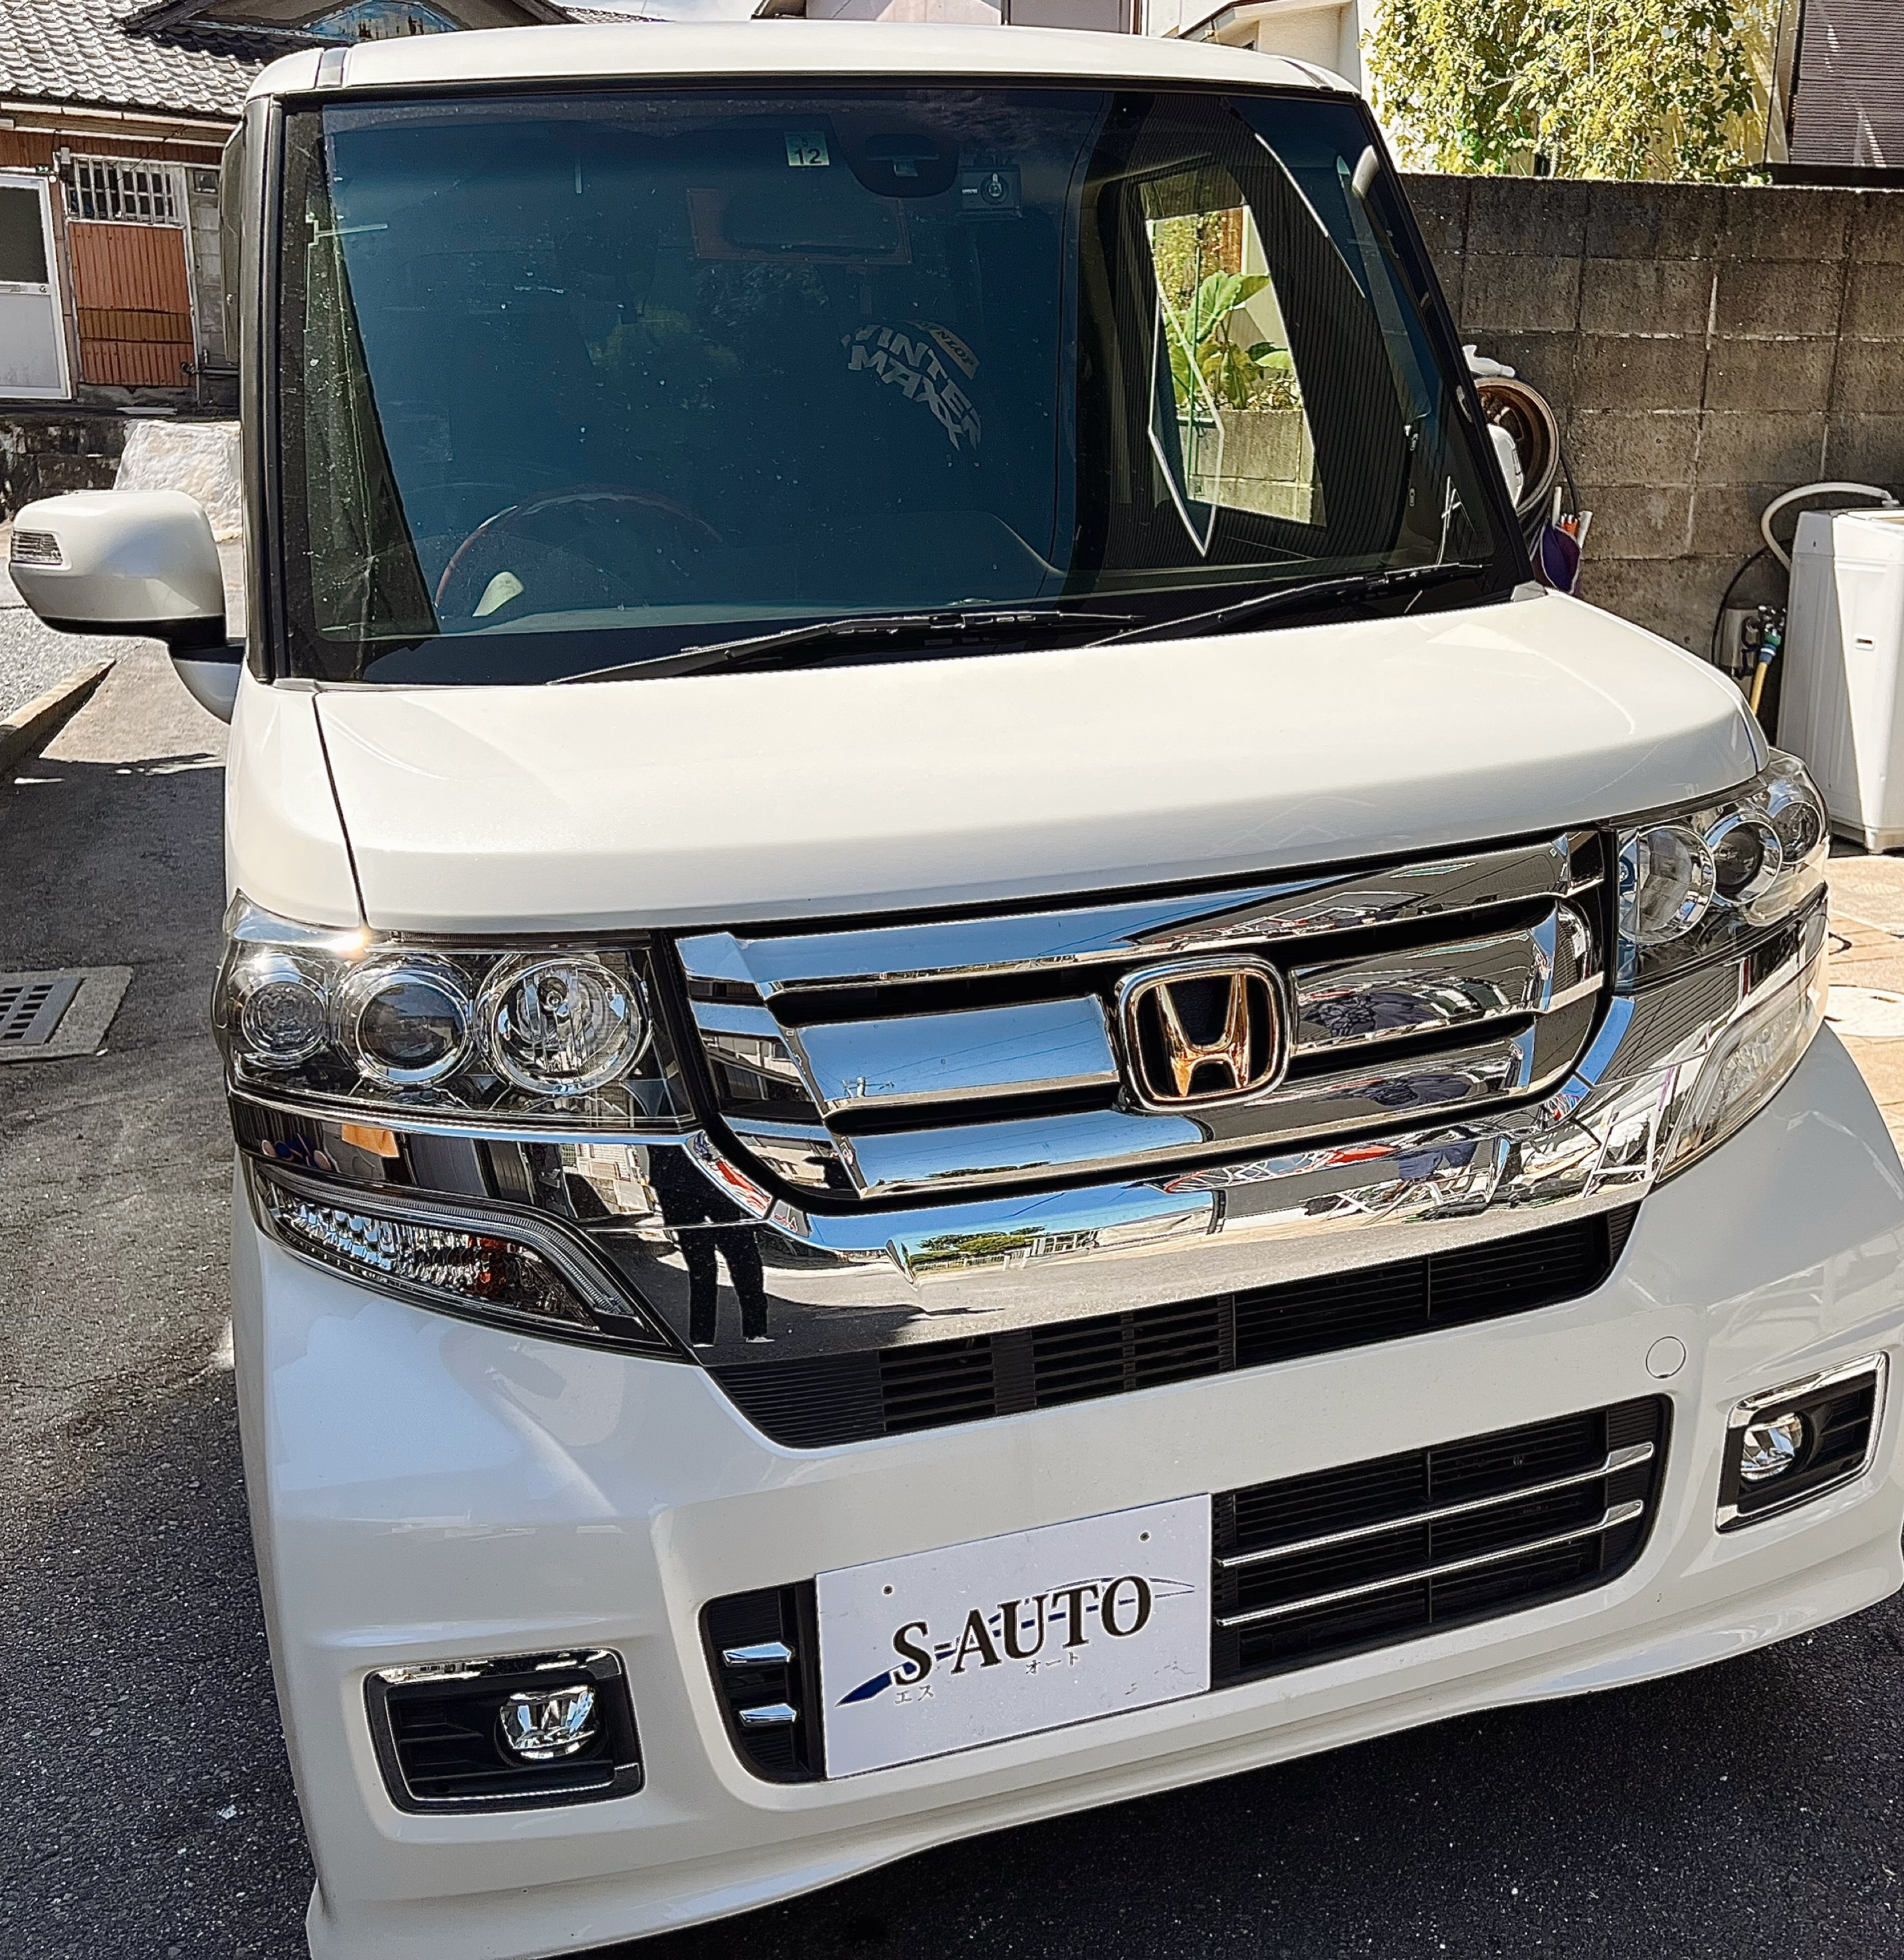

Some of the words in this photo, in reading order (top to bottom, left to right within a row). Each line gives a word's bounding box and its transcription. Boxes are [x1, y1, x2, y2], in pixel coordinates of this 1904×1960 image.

[794, 148, 822, 165] 12
[848, 345, 965, 452] MAXX
[892, 1575, 1152, 1686] S-AUTO
[894, 1685, 933, 1704] エス
[1025, 1651, 1078, 1674] オート
